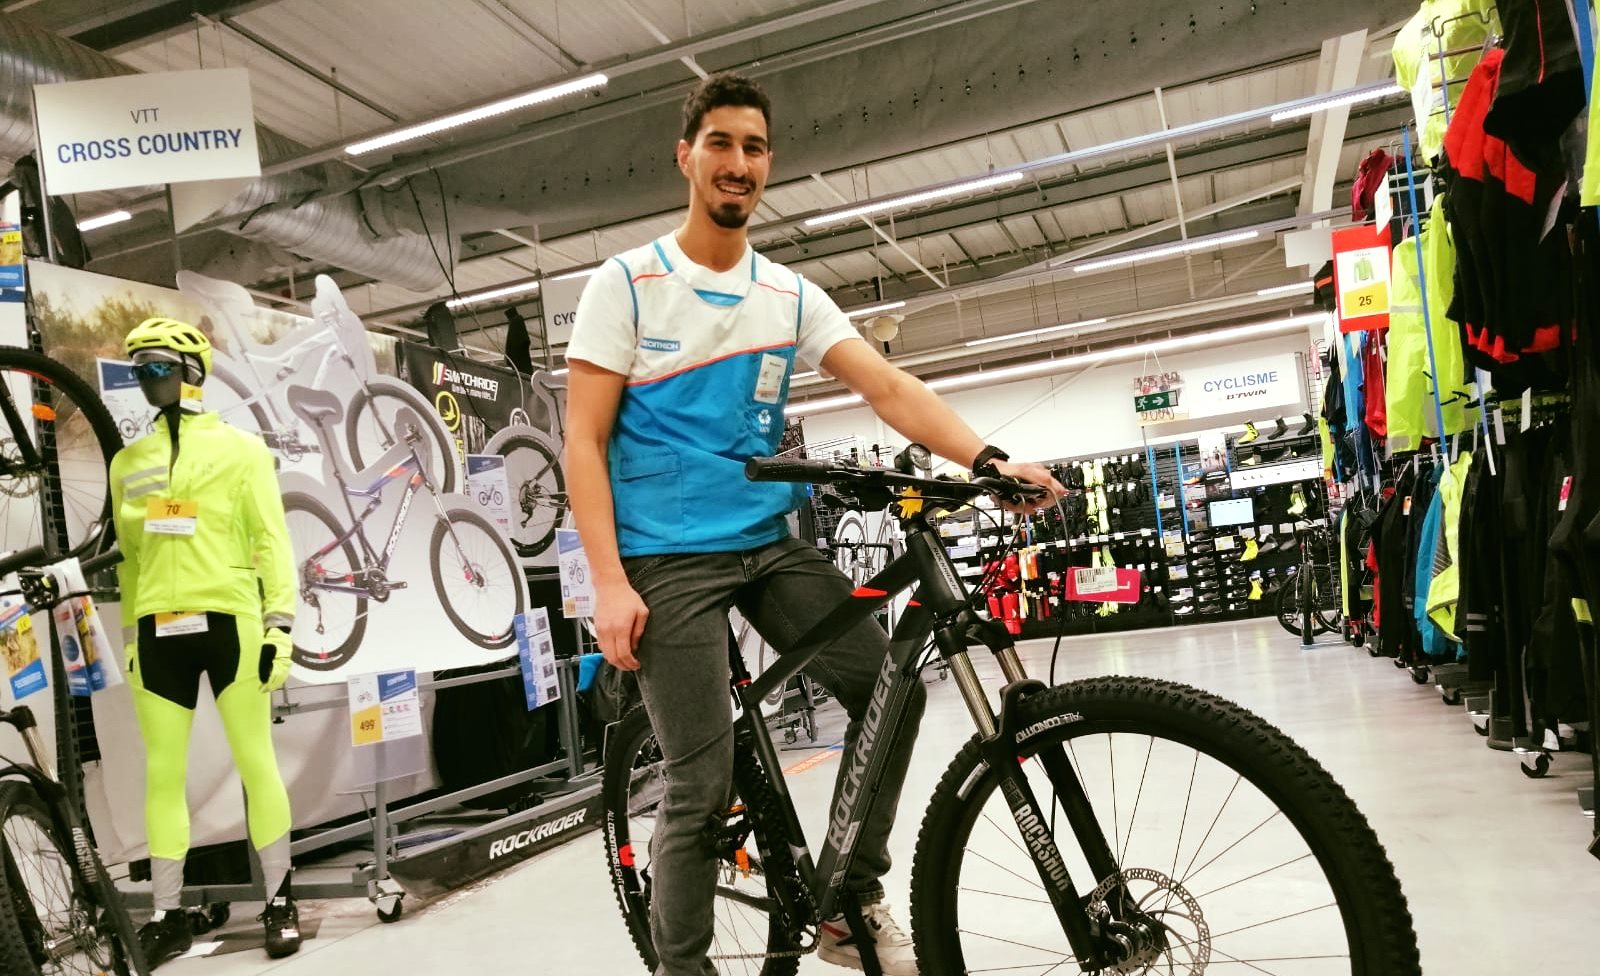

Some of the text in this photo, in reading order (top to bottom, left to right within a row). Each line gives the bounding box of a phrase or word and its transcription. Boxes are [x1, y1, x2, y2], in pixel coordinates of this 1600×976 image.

[130, 108, 159, 124] VTT
[57, 128, 242, 163] CROSS COUNTRY
[1203, 371, 1279, 393] CYCLISME
[827, 650, 898, 852] ROCKRIDER
[489, 807, 587, 860] ROCKRIDER
[1013, 803, 1070, 892] ROCKSHOX
